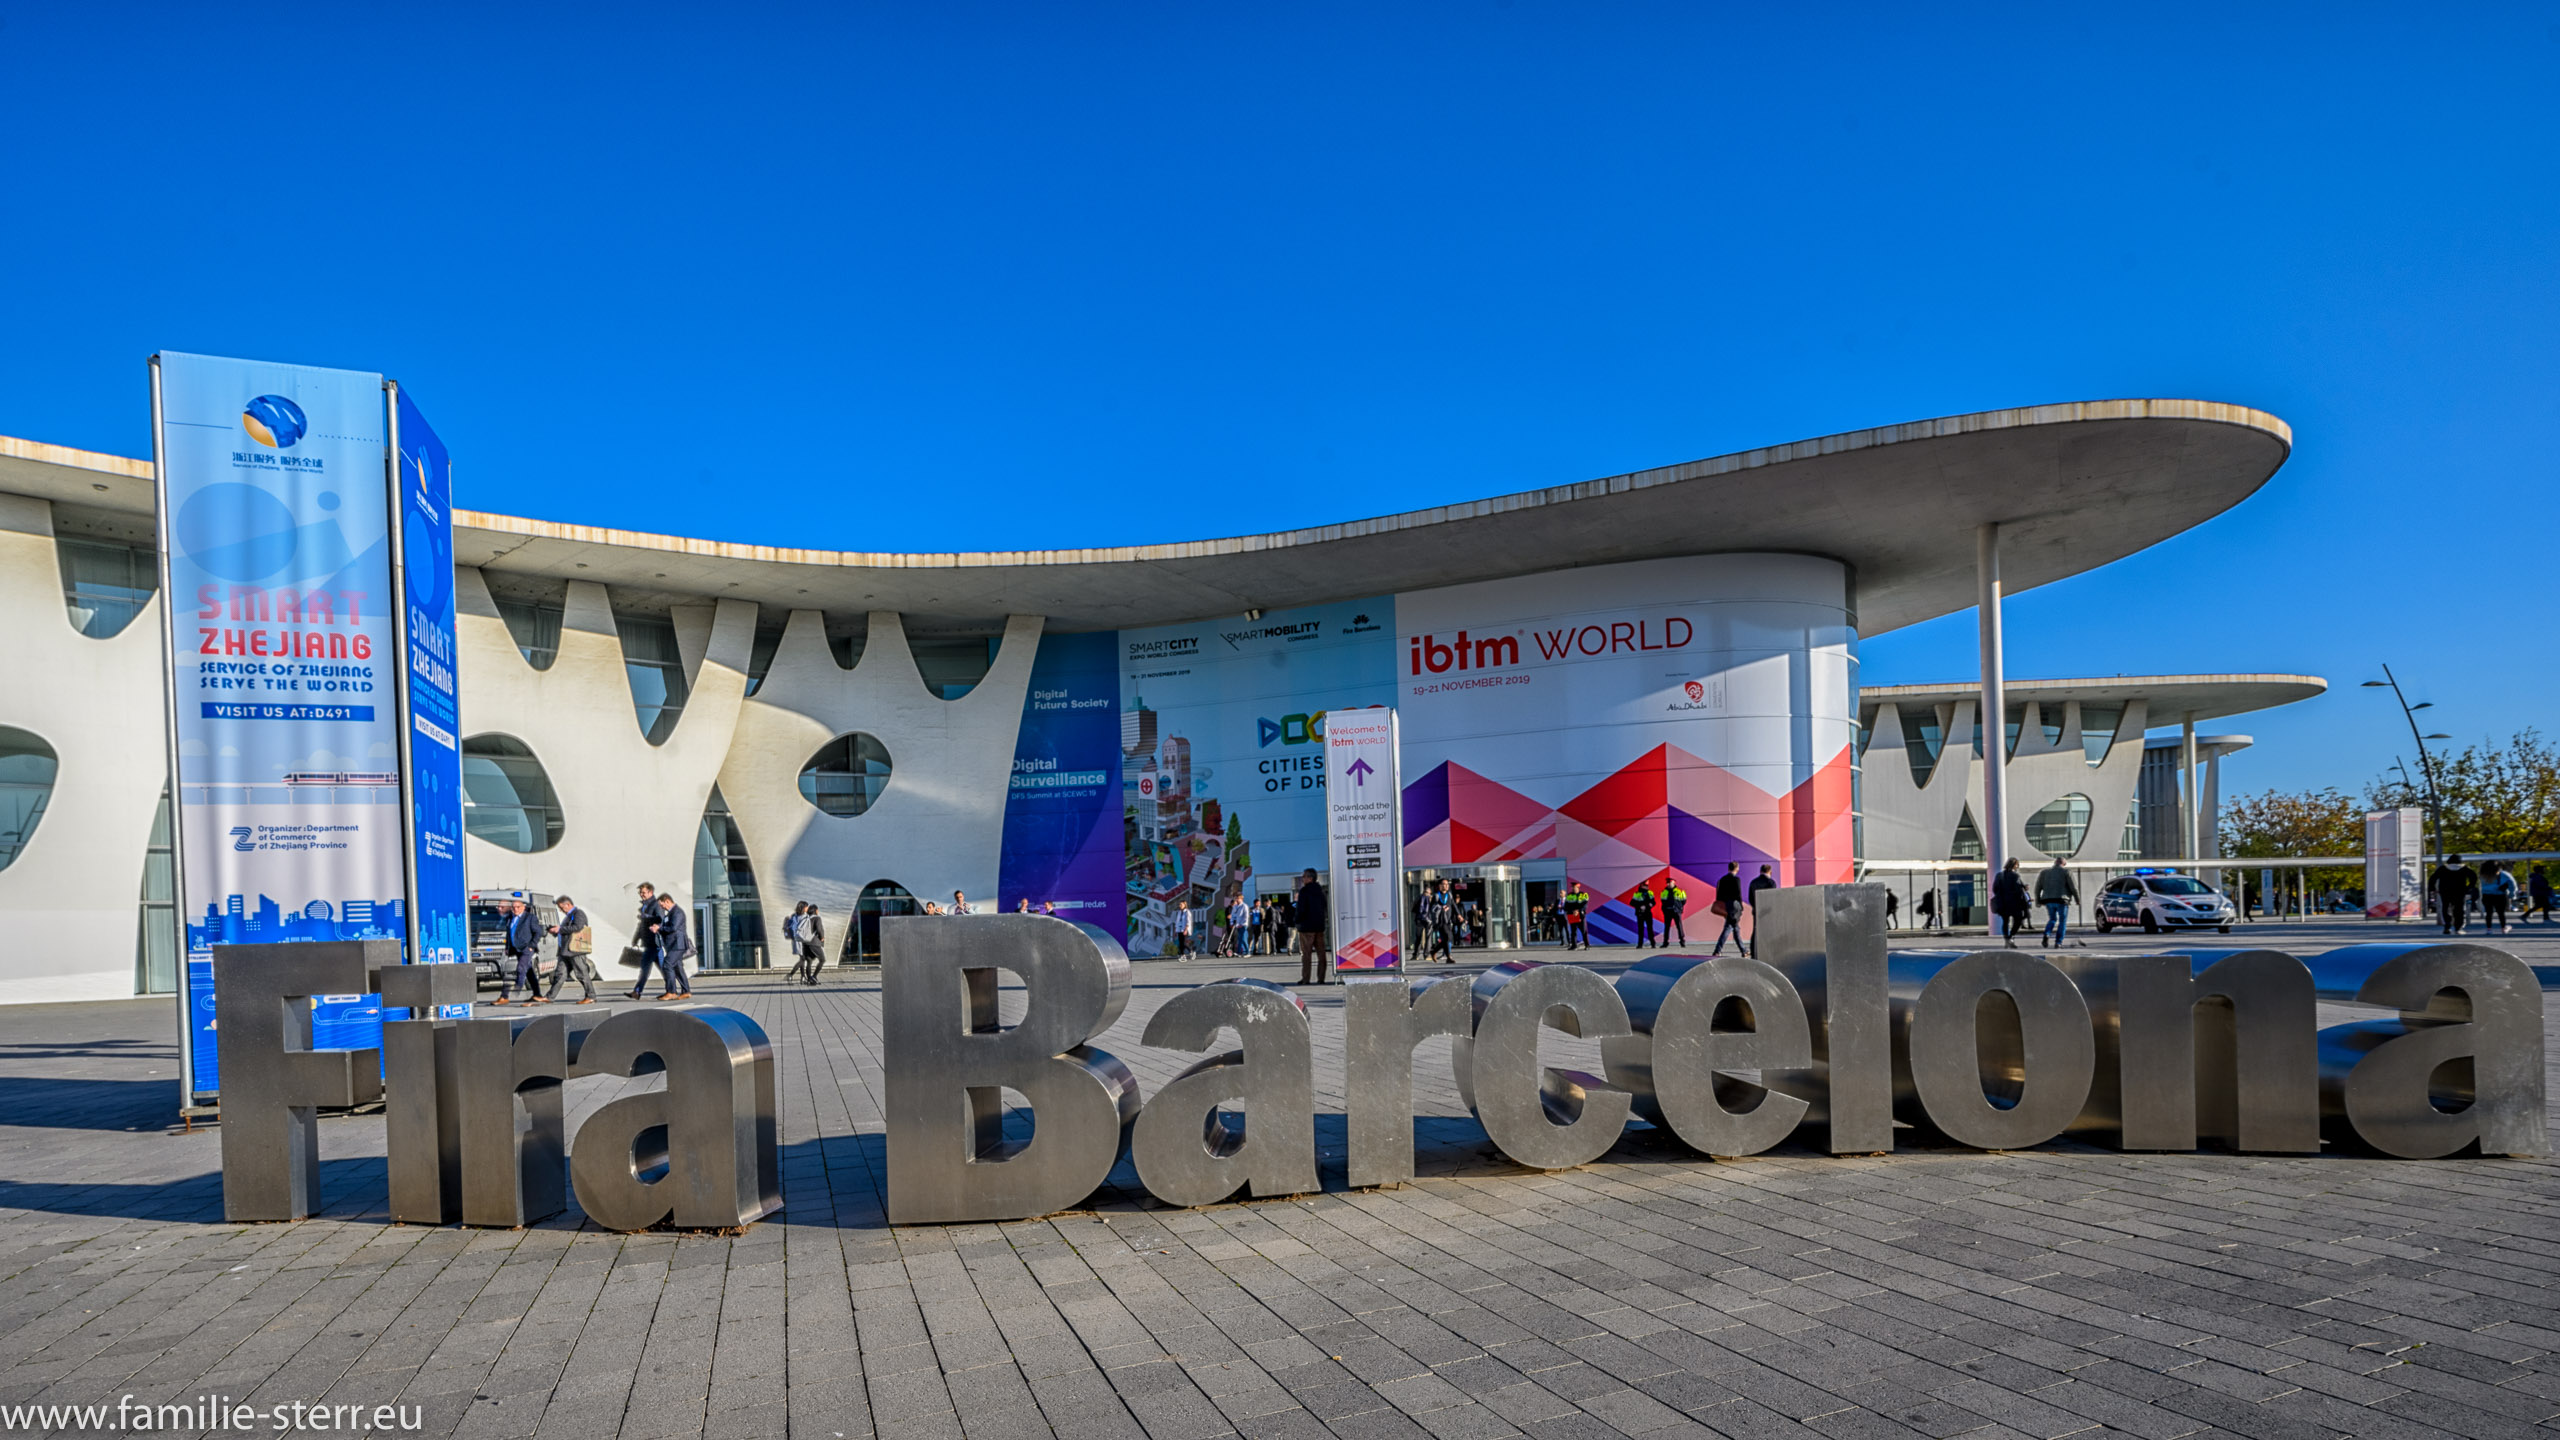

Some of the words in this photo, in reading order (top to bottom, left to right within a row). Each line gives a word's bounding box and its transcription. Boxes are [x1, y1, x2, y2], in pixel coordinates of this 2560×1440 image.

[197, 584, 368, 626] SMART
[412, 605, 451, 666] SMART
[1226, 621, 1320, 642] SMARTMOBILITY
[199, 628, 372, 660] ZHEJIANG
[1129, 637, 1198, 654] SMARTCITY
[1411, 631, 1519, 676] ibtm
[1534, 617, 1693, 661] WORLD
[200, 662, 267, 675] SERVICE
[272, 664, 295, 676] OF
[299, 665, 373, 678] ZHEJIANG
[413, 644, 453, 696] ZHEJIANG
[200, 677, 255, 689] SERVE
[264, 679, 298, 691] THE
[307, 680, 373, 692] WORLD
[1413, 685, 1439, 695] 19-21
[1441, 676, 1503, 692] NOVEMBER
[1505, 675, 1530, 685] 2019
[1034, 689, 1068, 700] Digital
[215, 705, 258, 717] VISIT
[263, 706, 284, 717] US
[1034, 702, 1068, 710] Future
[1071, 699, 1109, 708] Society
[1330, 726, 1374, 735] Welcome
[1332, 738, 1354, 747] ibtm
[1356, 737, 1386, 745] WORLD
[1012, 758, 1056, 773] Digital
[1259, 756, 1324, 774] CITIES
[1011, 773, 1105, 787] Surveillance
[1265, 777, 1291, 792] OF
[1334, 802, 1374, 812] Download
[1368, 812, 1386, 821] app!
[258, 825, 301, 833] Organizer
[270, 842, 308, 851] Zhejiang
[213, 938, 784, 1233] Fira
[879, 882, 2552, 1224] Barcelona
